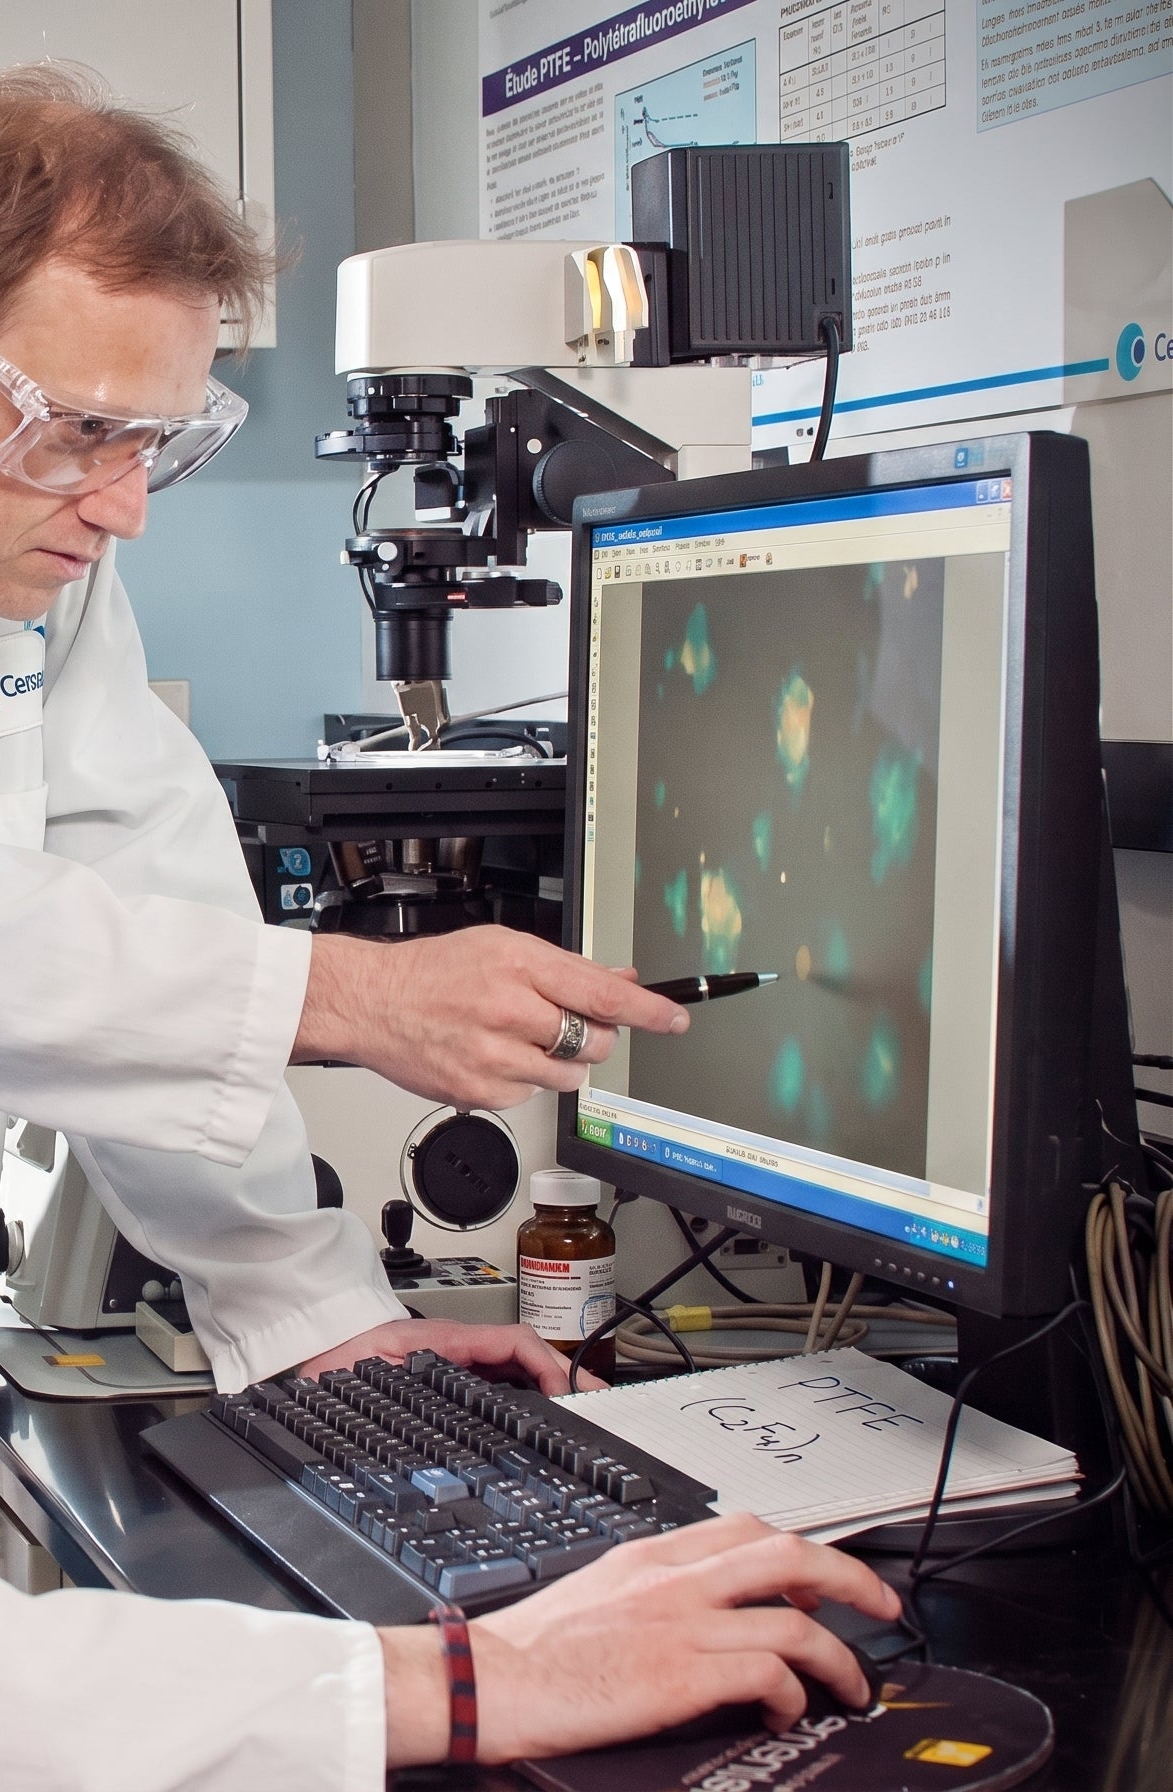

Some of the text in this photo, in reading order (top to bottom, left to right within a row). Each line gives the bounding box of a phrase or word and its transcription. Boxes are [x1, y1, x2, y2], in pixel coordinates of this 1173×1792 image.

[505, 67, 538, 98] Étude
[539, 46, 572, 83] PTFE
[778, 1376, 924, 1431] PTFE
